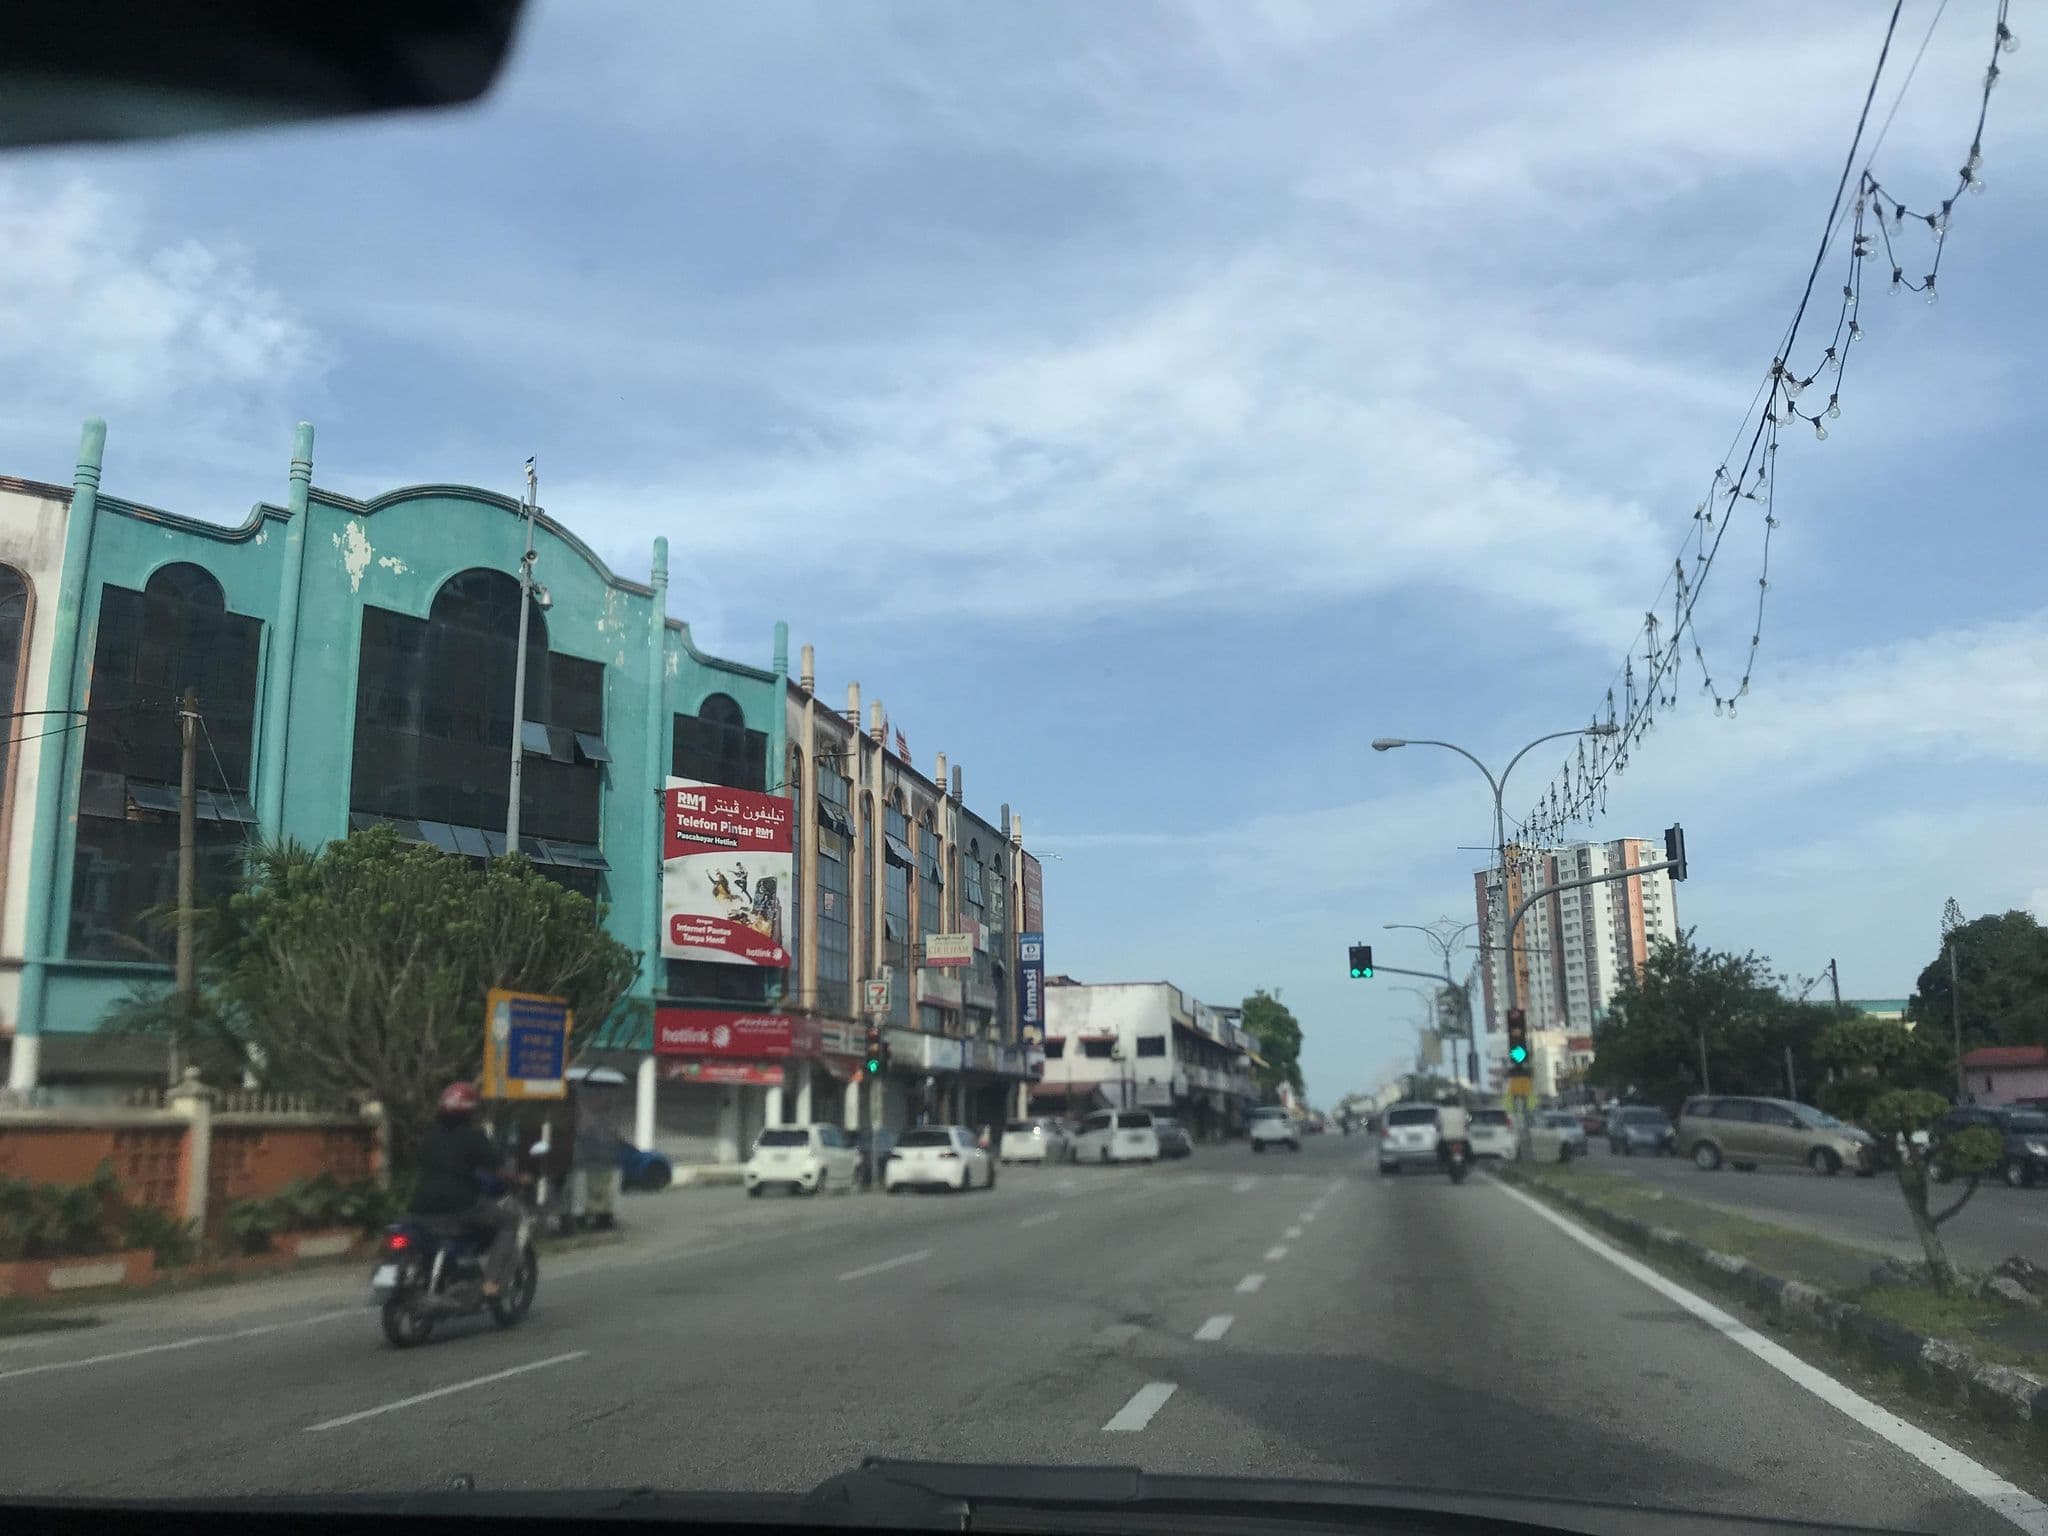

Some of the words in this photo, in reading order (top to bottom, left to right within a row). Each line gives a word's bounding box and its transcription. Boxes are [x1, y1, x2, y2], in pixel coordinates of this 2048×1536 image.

[677, 791, 706, 811] RM1
[676, 813, 717, 830] Telefon
[720, 821, 753, 836] Pintar
[755, 826, 773, 840] RM1
[677, 831, 714, 843] Pascabayar
[714, 836, 738, 847] Hotlink
[676, 923, 706, 933] Internet
[707, 926, 732, 936] Pantas
[682, 933, 705, 944] Tanpa
[746, 947, 772, 958] hotlink
[871, 984, 886, 1005] 7
[1023, 969, 1038, 1022] farmasi
[661, 1026, 710, 1044] hotlink
